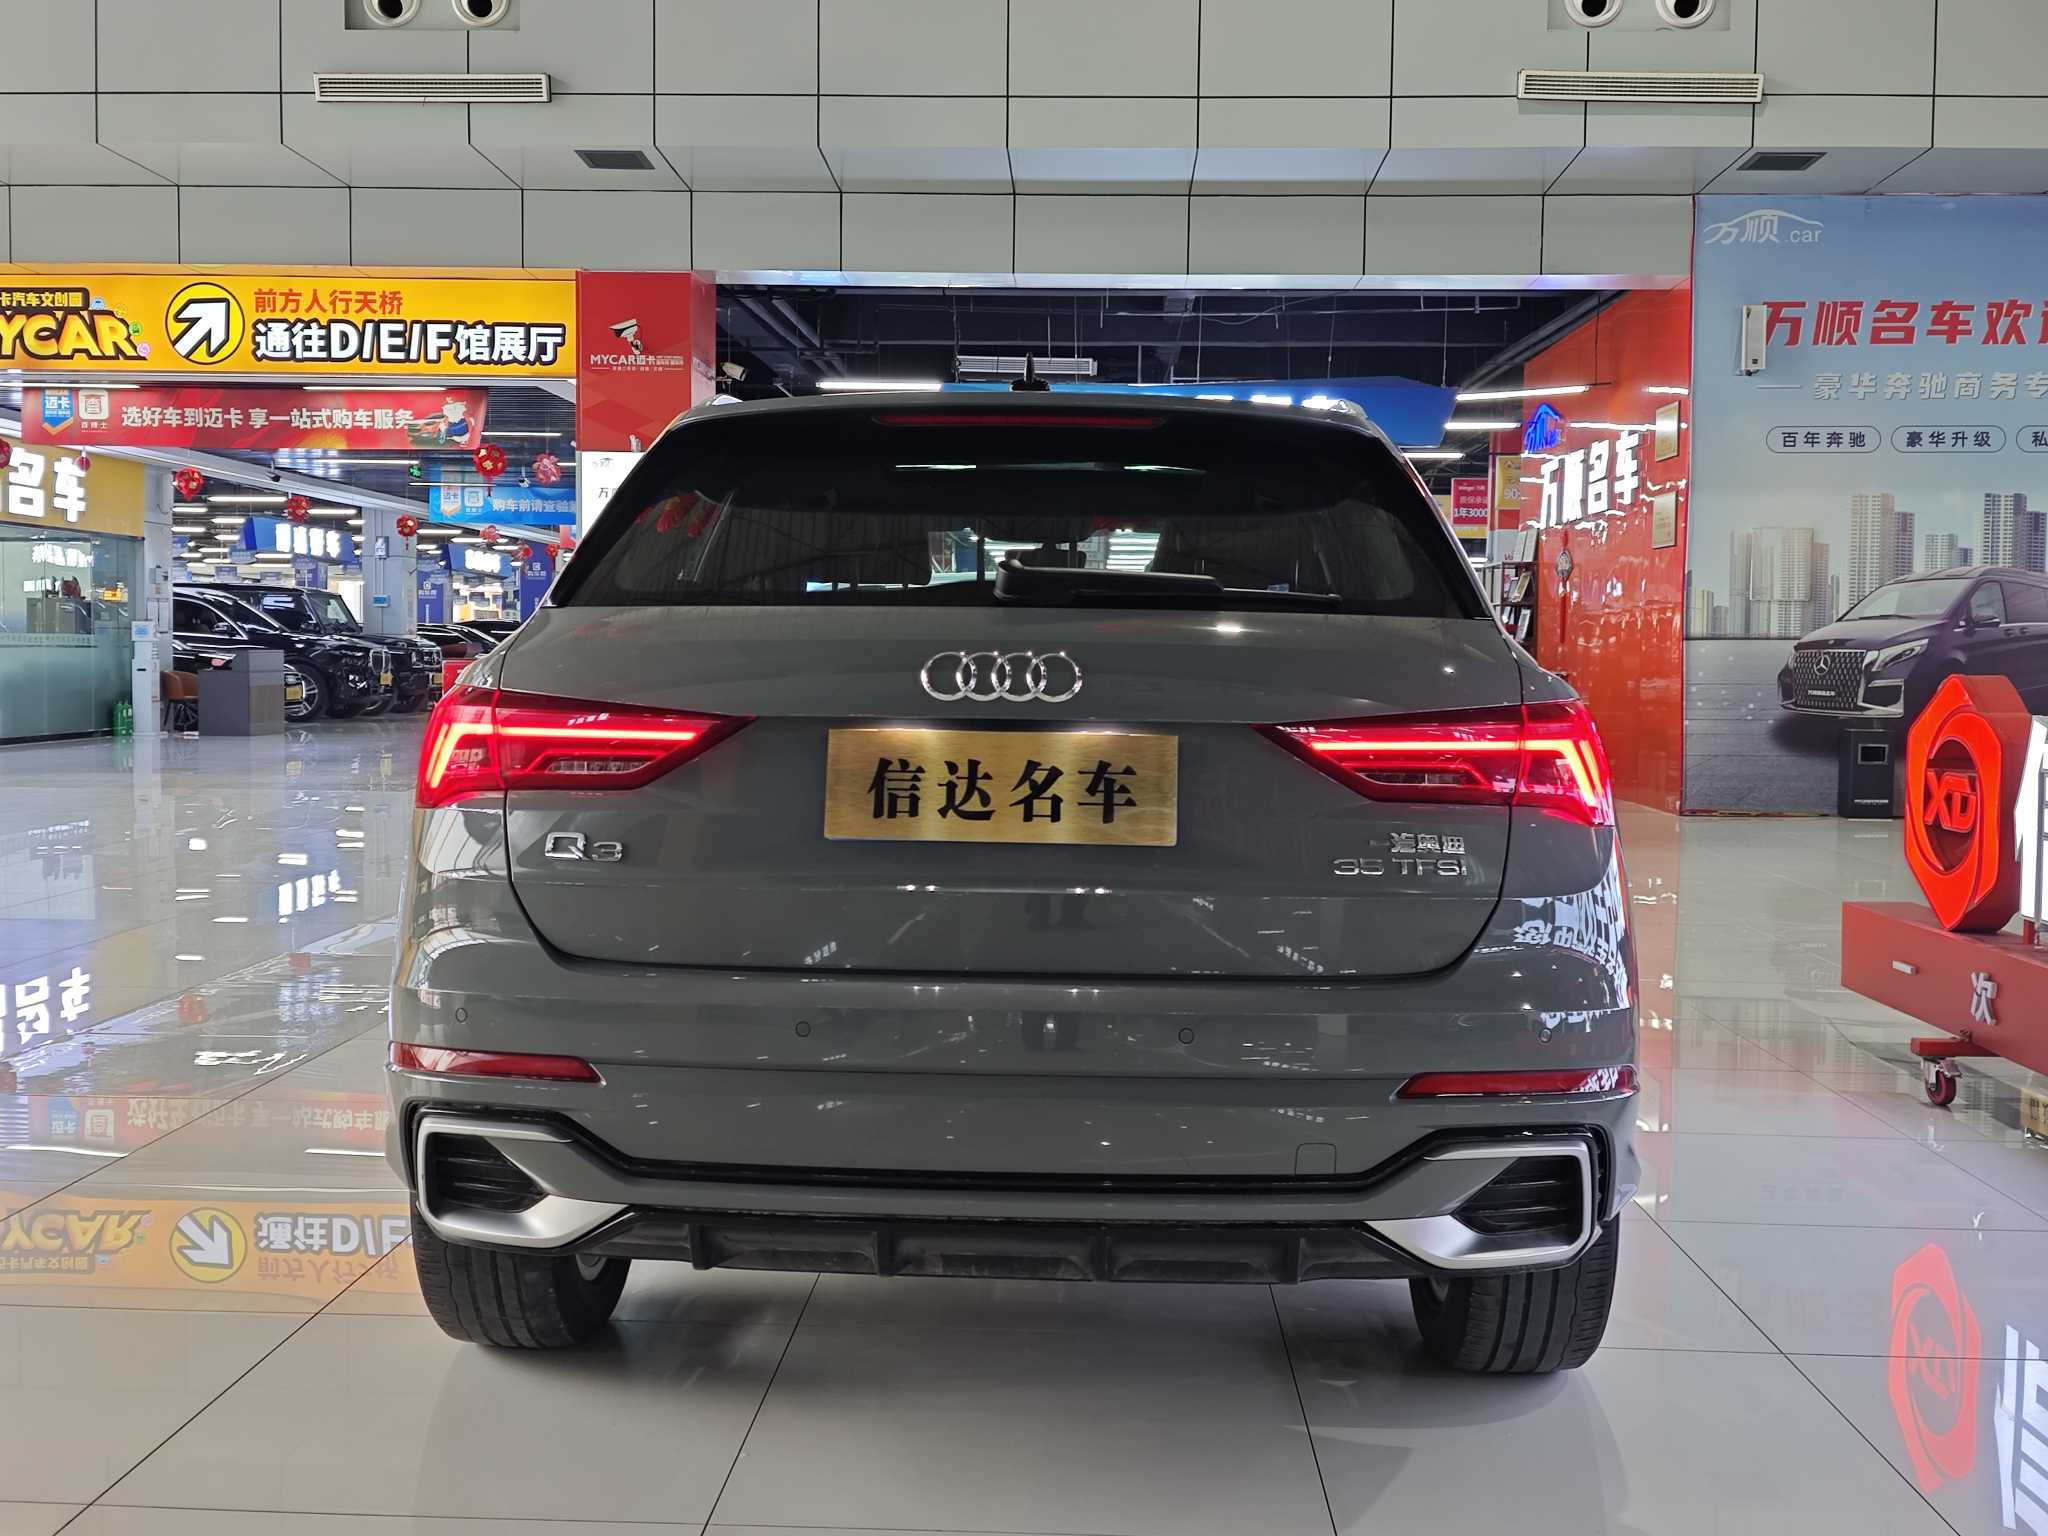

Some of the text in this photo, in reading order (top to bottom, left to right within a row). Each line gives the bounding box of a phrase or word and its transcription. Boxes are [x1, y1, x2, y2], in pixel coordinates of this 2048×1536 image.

[254, 289, 403, 314] 前方人行天桥
[1761, 300, 2048, 346] 万顺名车欢
[254, 321, 565, 362] 通往D/E/F馆展厅
[121, 406, 414, 430] 选好车到迈卡 享一站式购车服务
[1781, 431, 1867, 448] 百年奔驰
[1906, 431, 1992, 448] 豪华升级
[867, 757, 1137, 825] 信达名车
[545, 831, 623, 862] Q3
[1333, 858, 1385, 876] 35
